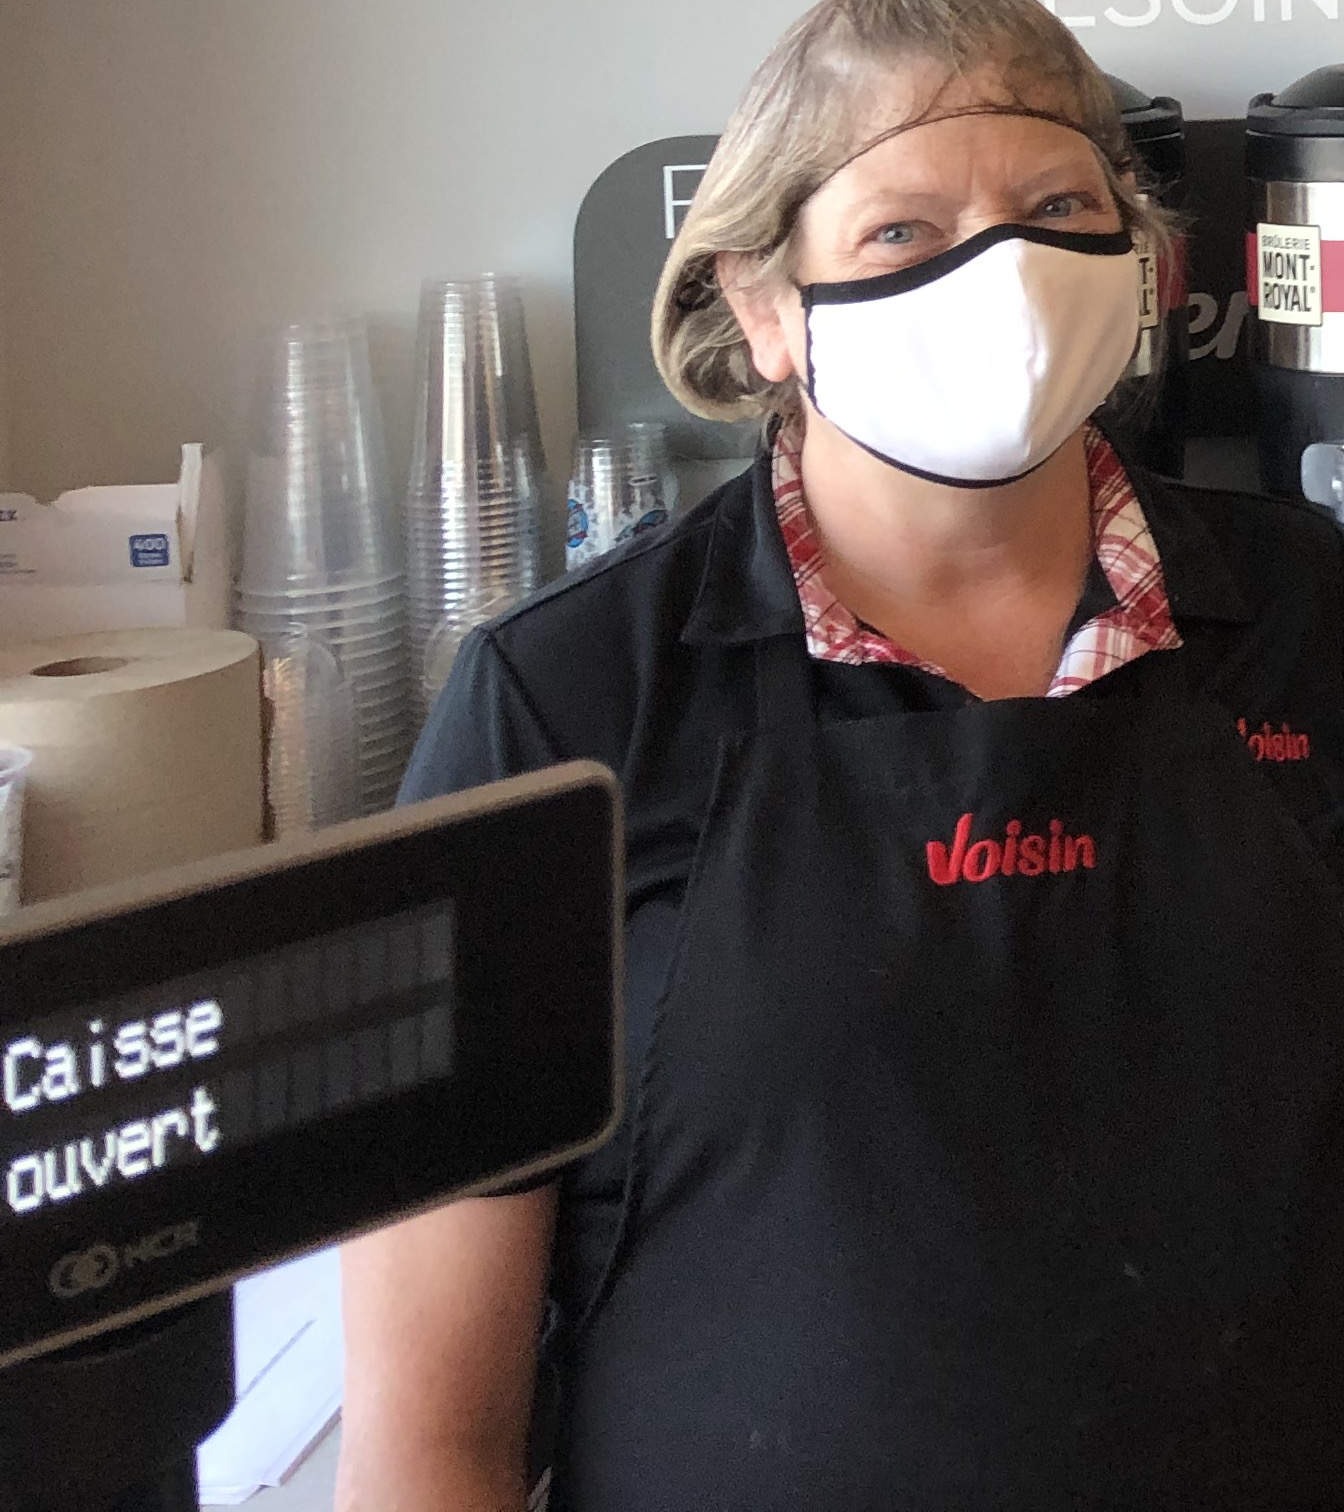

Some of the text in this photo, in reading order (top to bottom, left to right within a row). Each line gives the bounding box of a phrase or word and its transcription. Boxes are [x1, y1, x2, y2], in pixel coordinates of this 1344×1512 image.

[1238, 717, 1310, 761] oisin
[926, 813, 1097, 885] Voisin
[3, 997, 224, 1114] Caisse
[6, 1086, 222, 1215] ouvert
